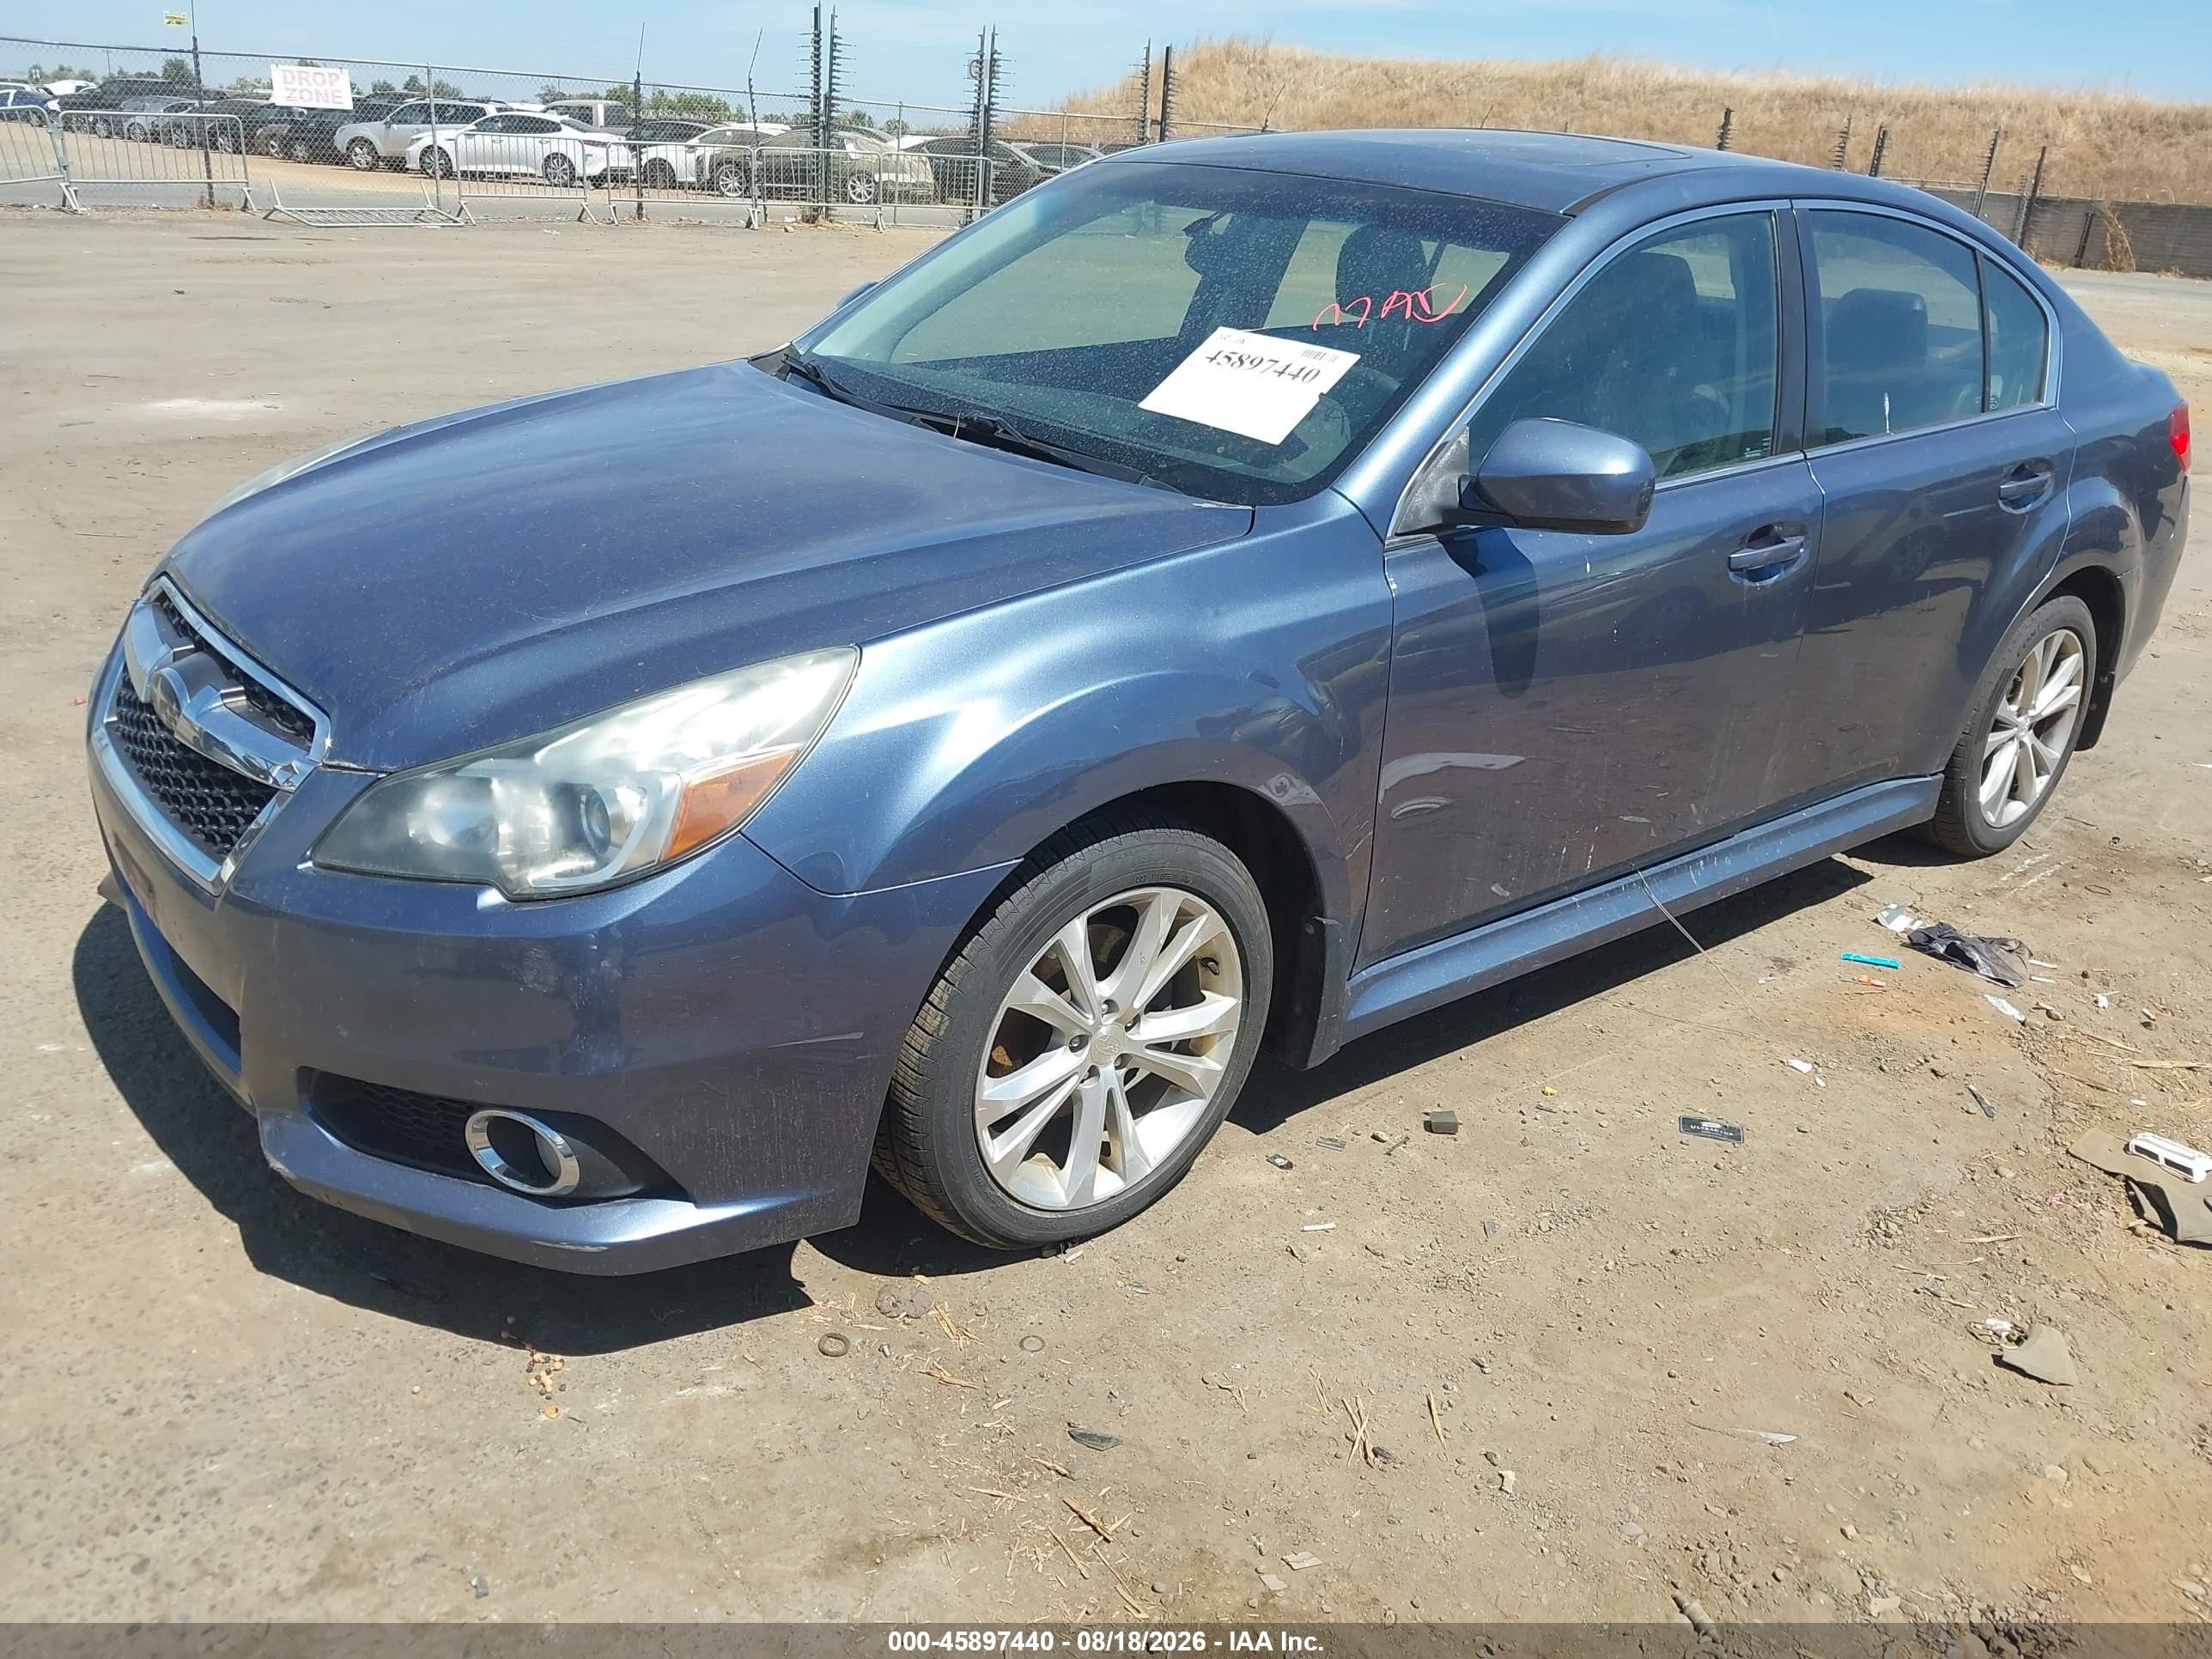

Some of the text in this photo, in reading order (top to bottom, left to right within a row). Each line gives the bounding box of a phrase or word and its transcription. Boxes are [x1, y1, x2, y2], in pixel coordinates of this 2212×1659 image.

[283, 70, 340, 87] DROP
[284, 88, 343, 104] ZONE
[1206, 349, 1321, 383] 45897440
